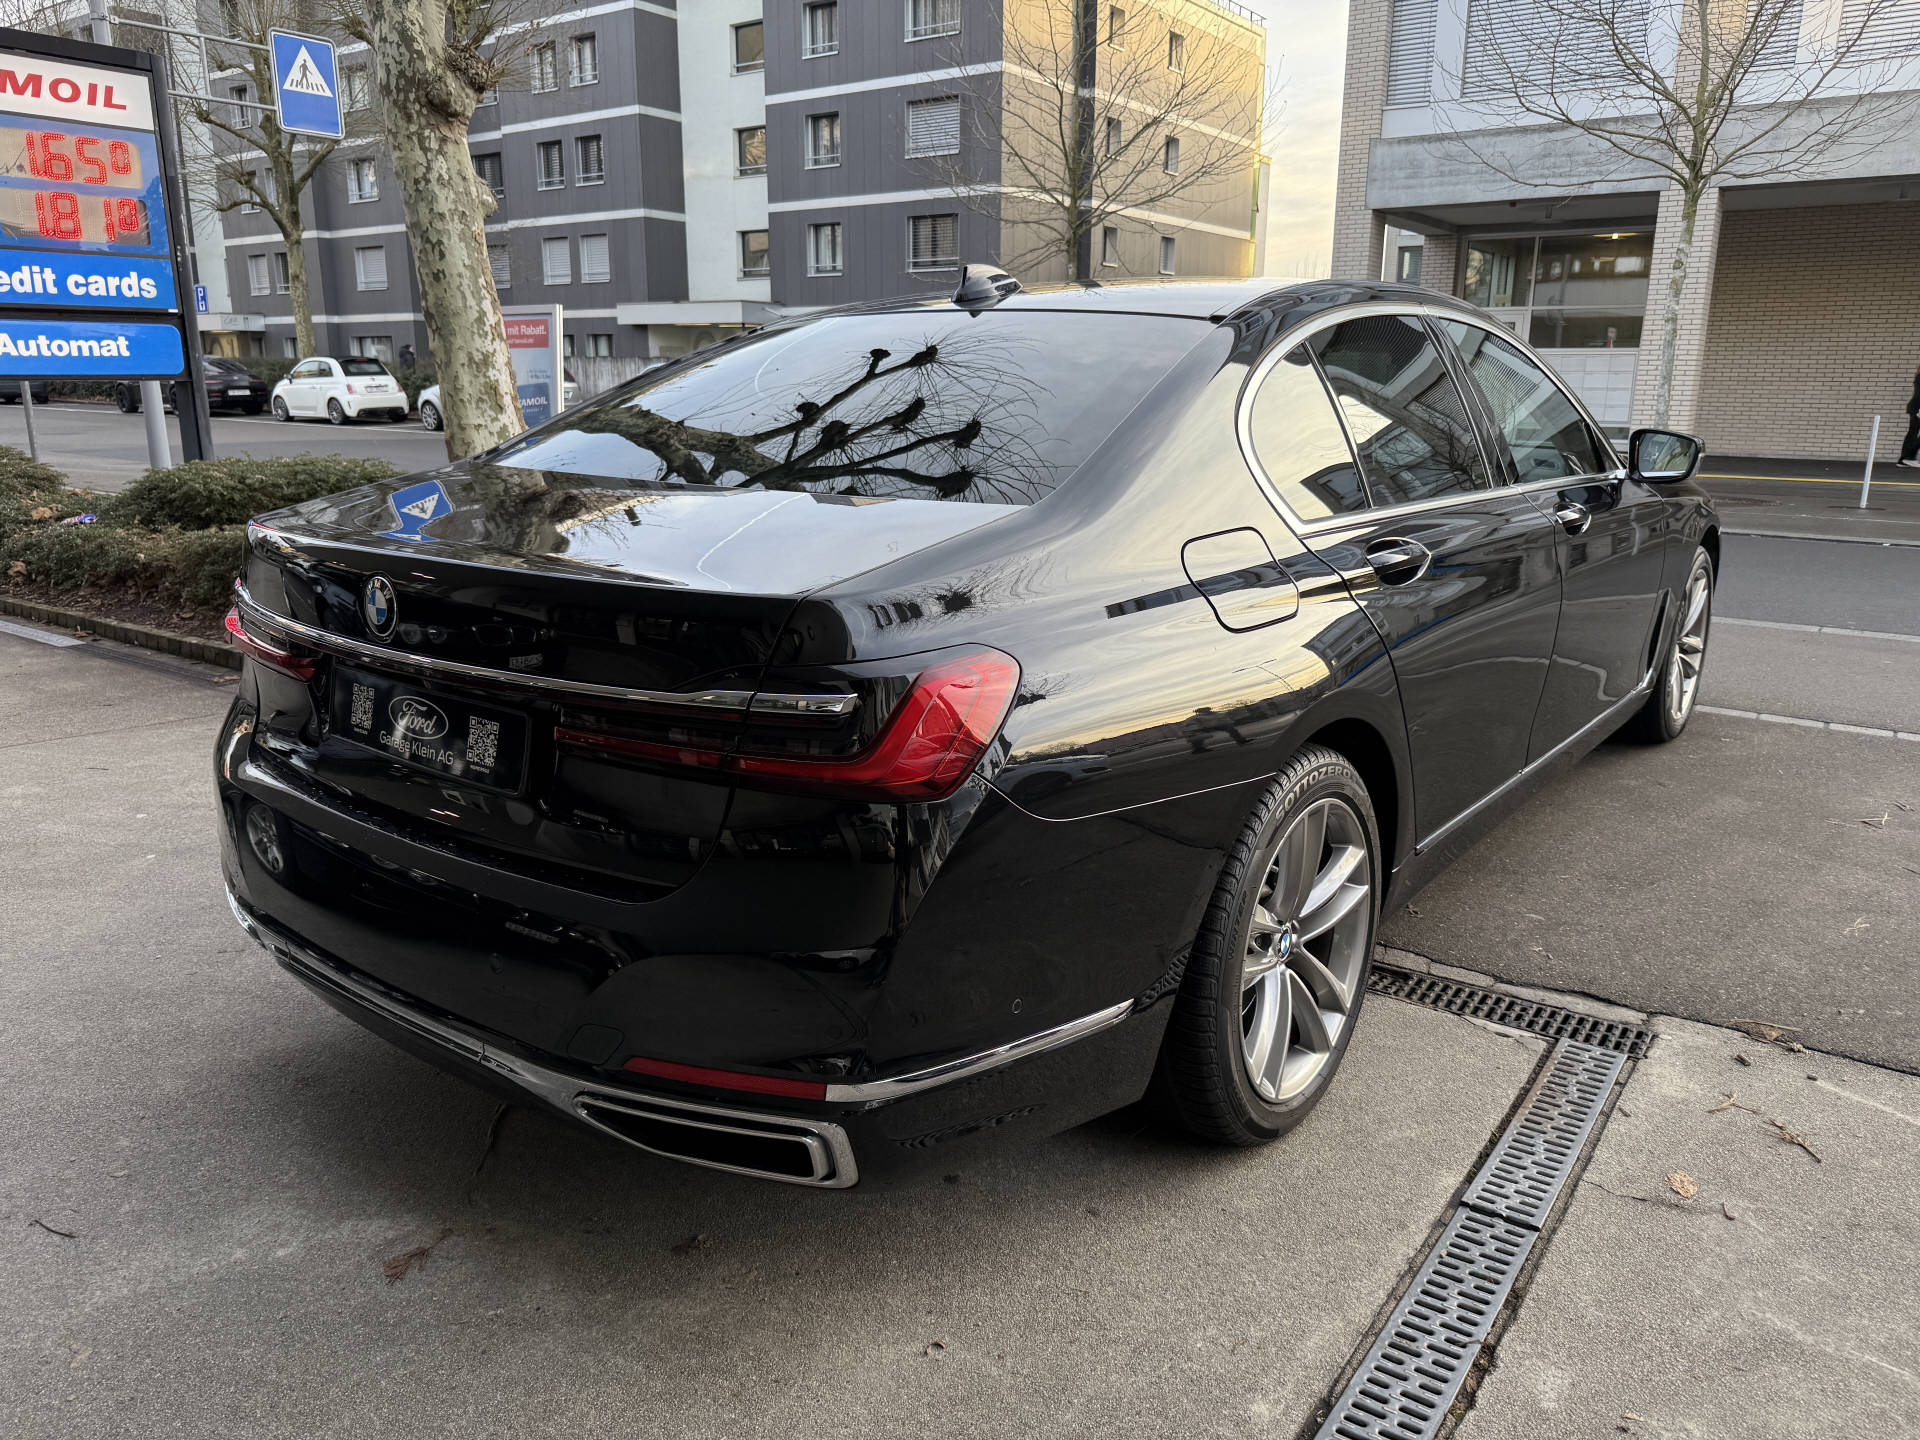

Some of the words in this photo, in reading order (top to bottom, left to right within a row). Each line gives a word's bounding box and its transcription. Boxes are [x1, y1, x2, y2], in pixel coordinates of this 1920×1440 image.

[0, 68, 127, 110] MOIL
[66, 271, 158, 299] cards
[0, 332, 131, 357] Automat
[520, 396, 548, 407] AMOIL
[397, 699, 438, 735] Ford
[380, 730, 410, 753] Garage
[412, 740, 436, 761] Klein
[437, 749, 454, 766] AG
[1275, 766, 1351, 821] SOTTOZERO
